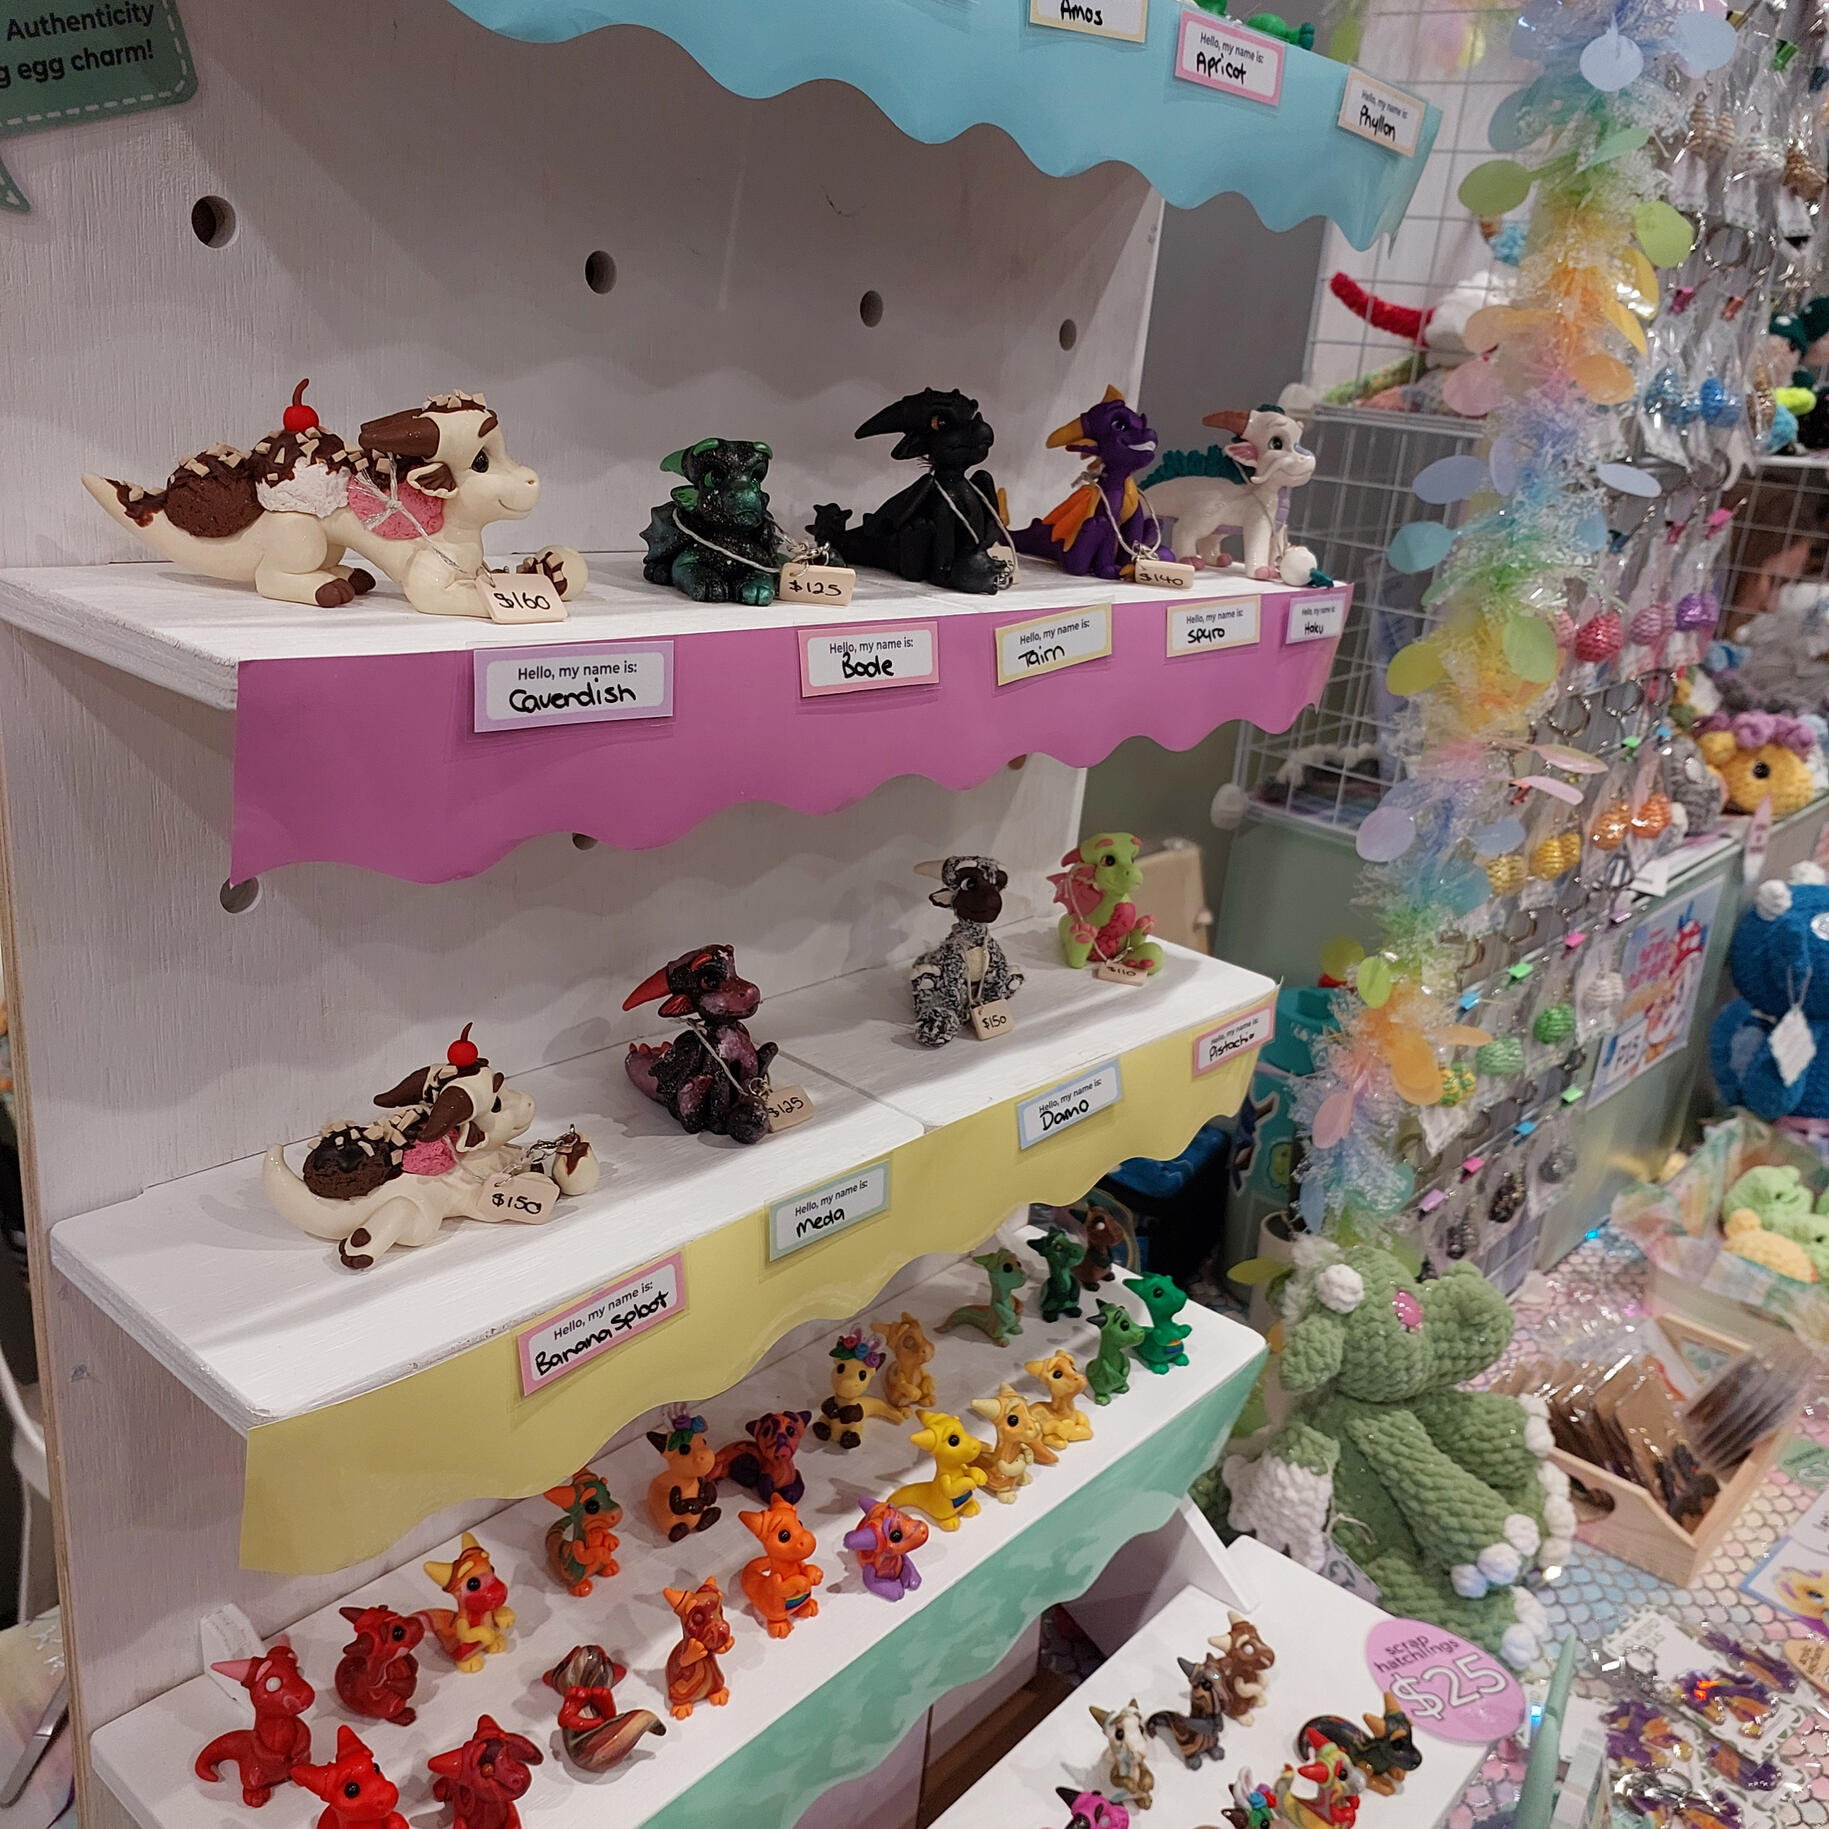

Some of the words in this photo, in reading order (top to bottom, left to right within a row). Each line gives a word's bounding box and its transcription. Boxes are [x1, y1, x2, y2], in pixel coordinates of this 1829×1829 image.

[7, 1, 154, 41] Authenticity
[1060, 0, 1103, 26] Amos
[1200, 32, 1221, 51] Hello,
[1222, 42, 1235, 56] my
[1235, 46, 1255, 61] name
[17, 57, 65, 83] egg
[71, 39, 154, 71] charm!
[1196, 51, 1247, 85] Apricot
[788, 579, 842, 597] $125
[1139, 572, 1184, 586] $140
[494, 591, 551, 610] $160
[1206, 613, 1217, 623] my
[1217, 610, 1235, 620] name
[1020, 630, 1042, 645] Hello,
[1043, 628, 1056, 640] my
[1057, 621, 1080, 636] name
[1080, 619, 1090, 629] is:
[829, 642, 857, 655] Hello,
[859, 641, 875, 654] my
[876, 638, 902, 651] name
[903, 636, 914, 648] is:
[1018, 645, 1066, 668] Tairn
[518, 666, 555, 681] Hello,
[558, 664, 580, 680] my
[583, 662, 621, 676] name
[623, 660, 637, 673] is:
[509, 677, 637, 714] Cavendish
[982, 1014, 1007, 1030] $150
[768, 1096, 804, 1118] $125
[1039, 1099, 1060, 1114] Hello,
[1060, 1092, 1073, 1103] my
[1073, 1083, 1093, 1097] name
[1093, 1078, 1102, 1088] is:
[1040, 1098, 1089, 1131] Damo
[492, 1193, 542, 1215] $150
[794, 1202, 819, 1217] Hello,
[820, 1194, 834, 1206] my
[835, 1184, 858, 1200] name
[859, 1179, 869, 1189] is:
[553, 1318, 586, 1341] Hello,
[587, 1306, 605, 1322] my
[608, 1288, 639, 1311] name
[641, 1280, 654, 1294] is:
[535, 1328, 613, 1376] Banana
[1373, 1639, 1460, 1673] hatchlings
[1385, 1634, 1430, 1656] scrap
[1389, 1652, 1508, 1721] $25
